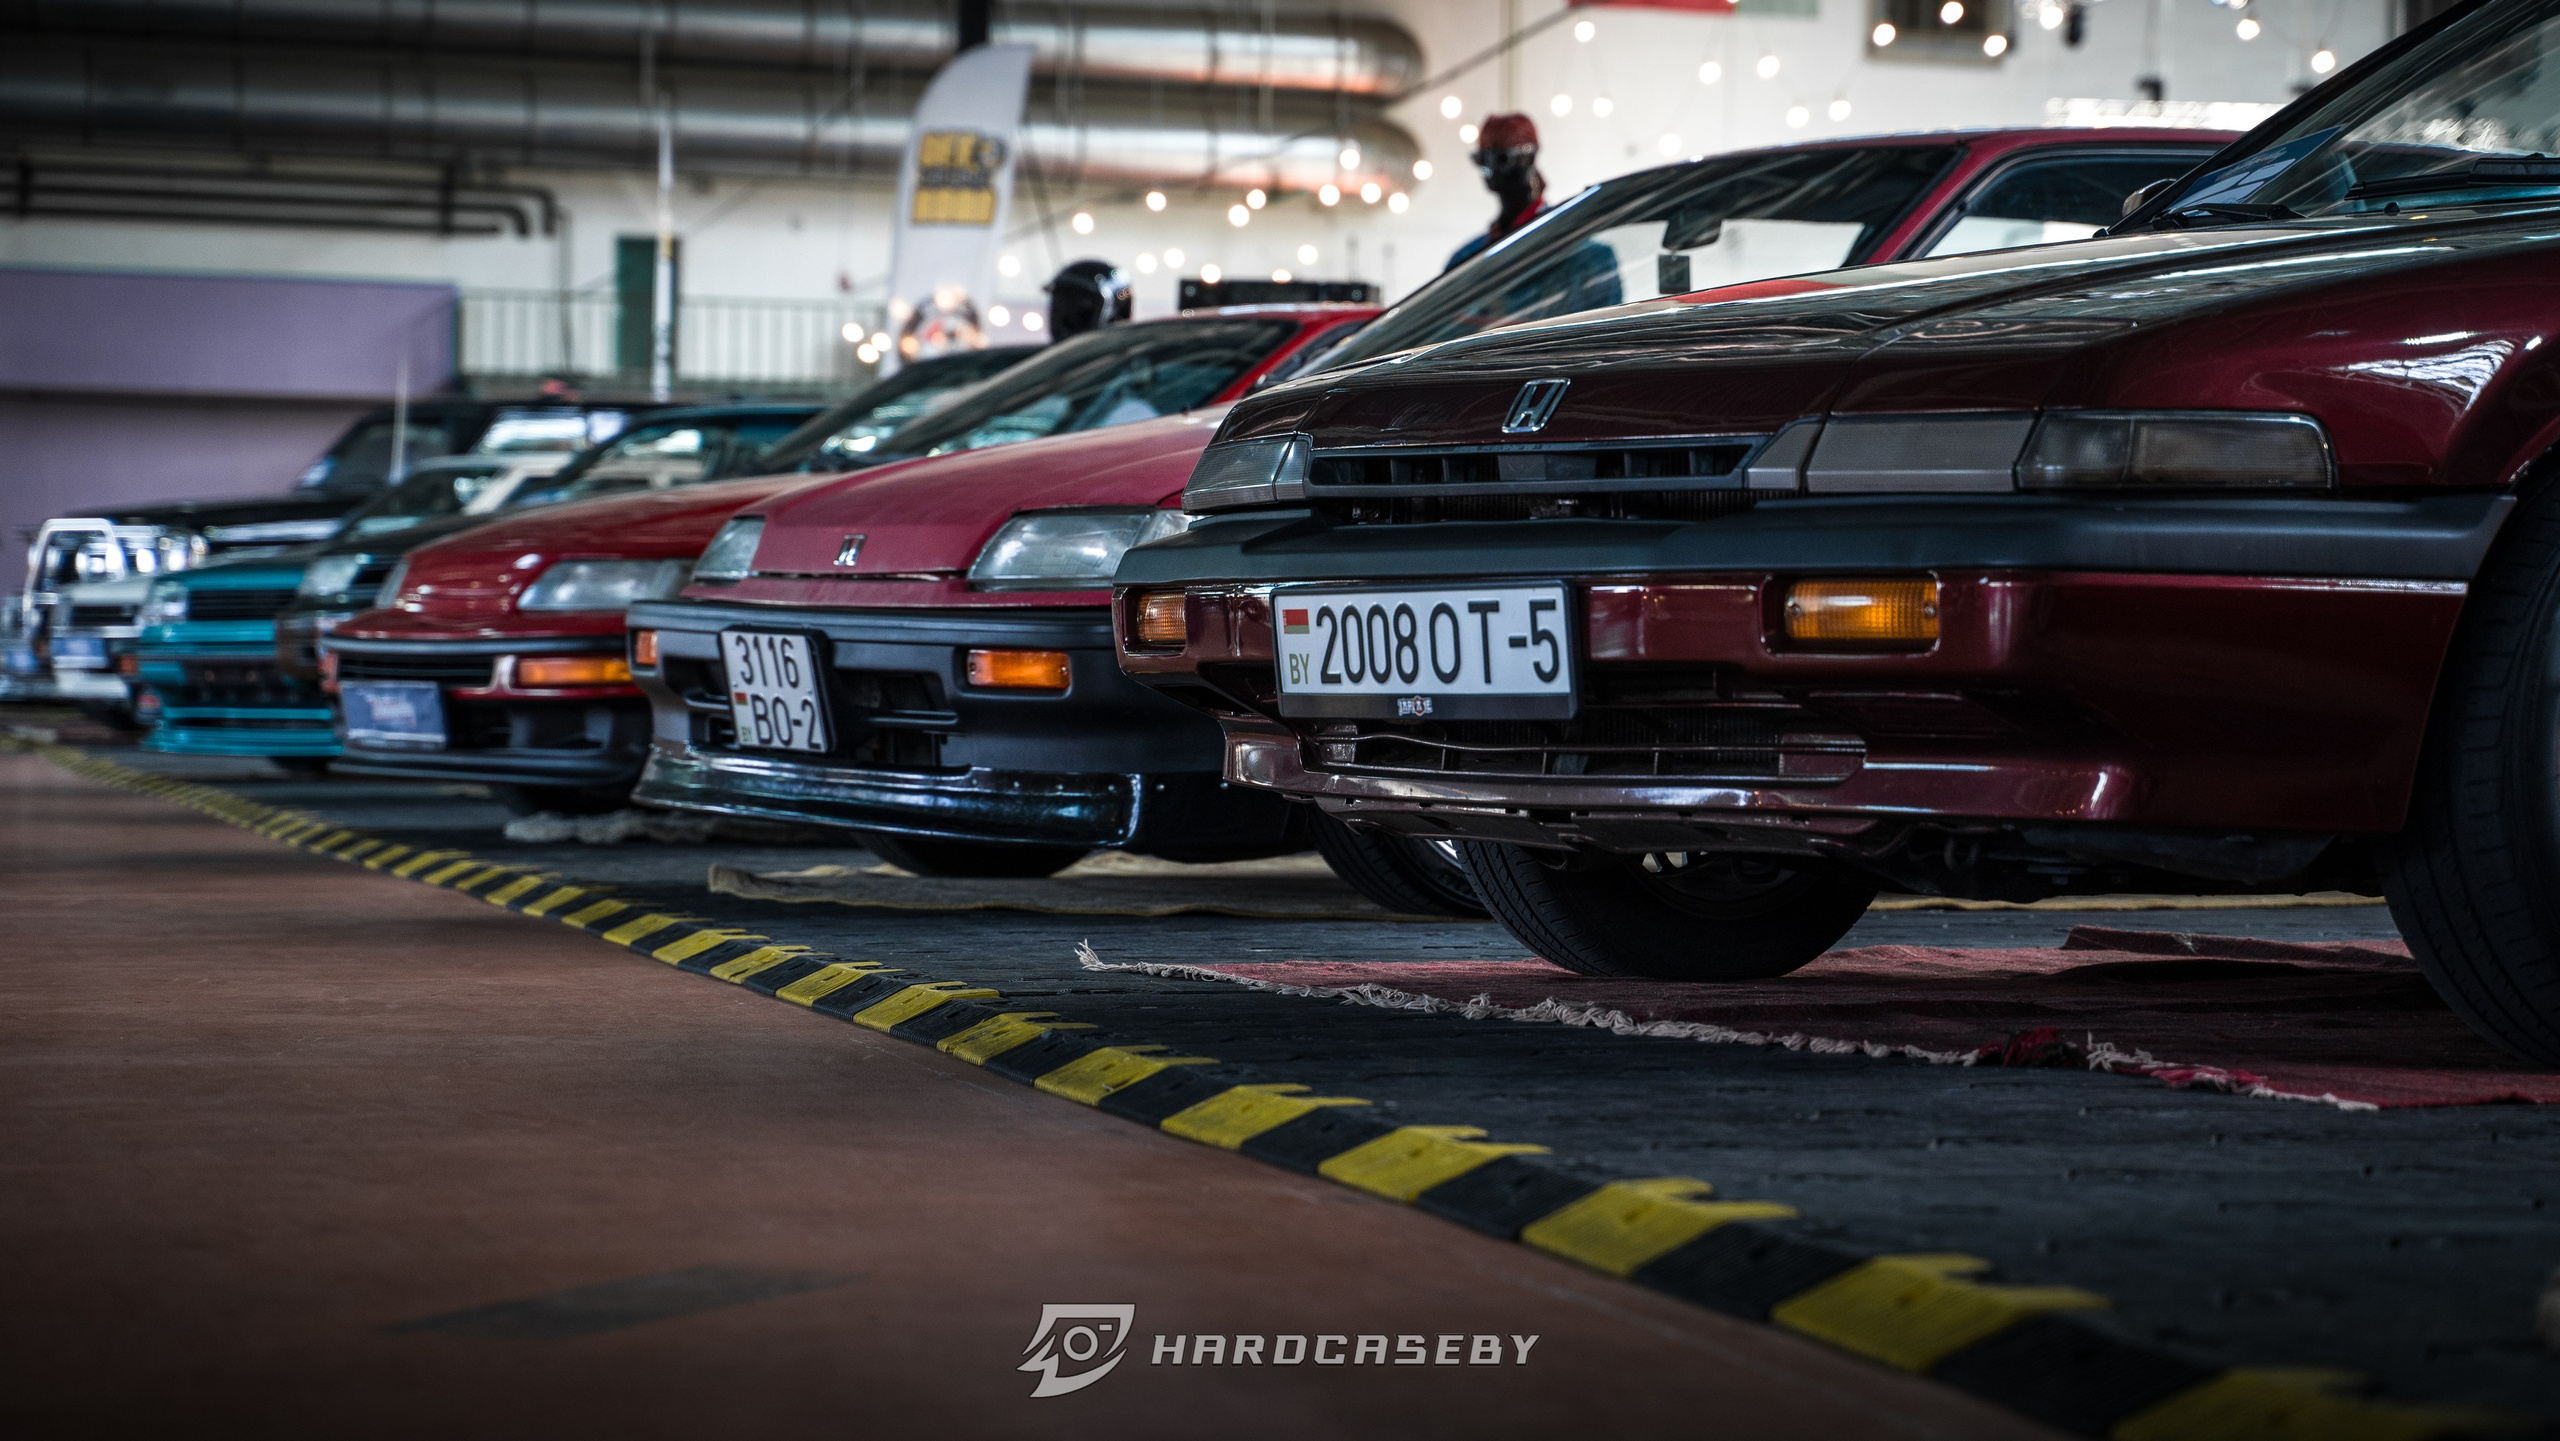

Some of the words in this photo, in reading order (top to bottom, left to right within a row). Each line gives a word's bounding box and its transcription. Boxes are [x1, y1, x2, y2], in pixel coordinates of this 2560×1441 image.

[735, 635, 799, 689] 3116
[1289, 653, 1310, 685] BY
[751, 694, 821, 749] BO-2
